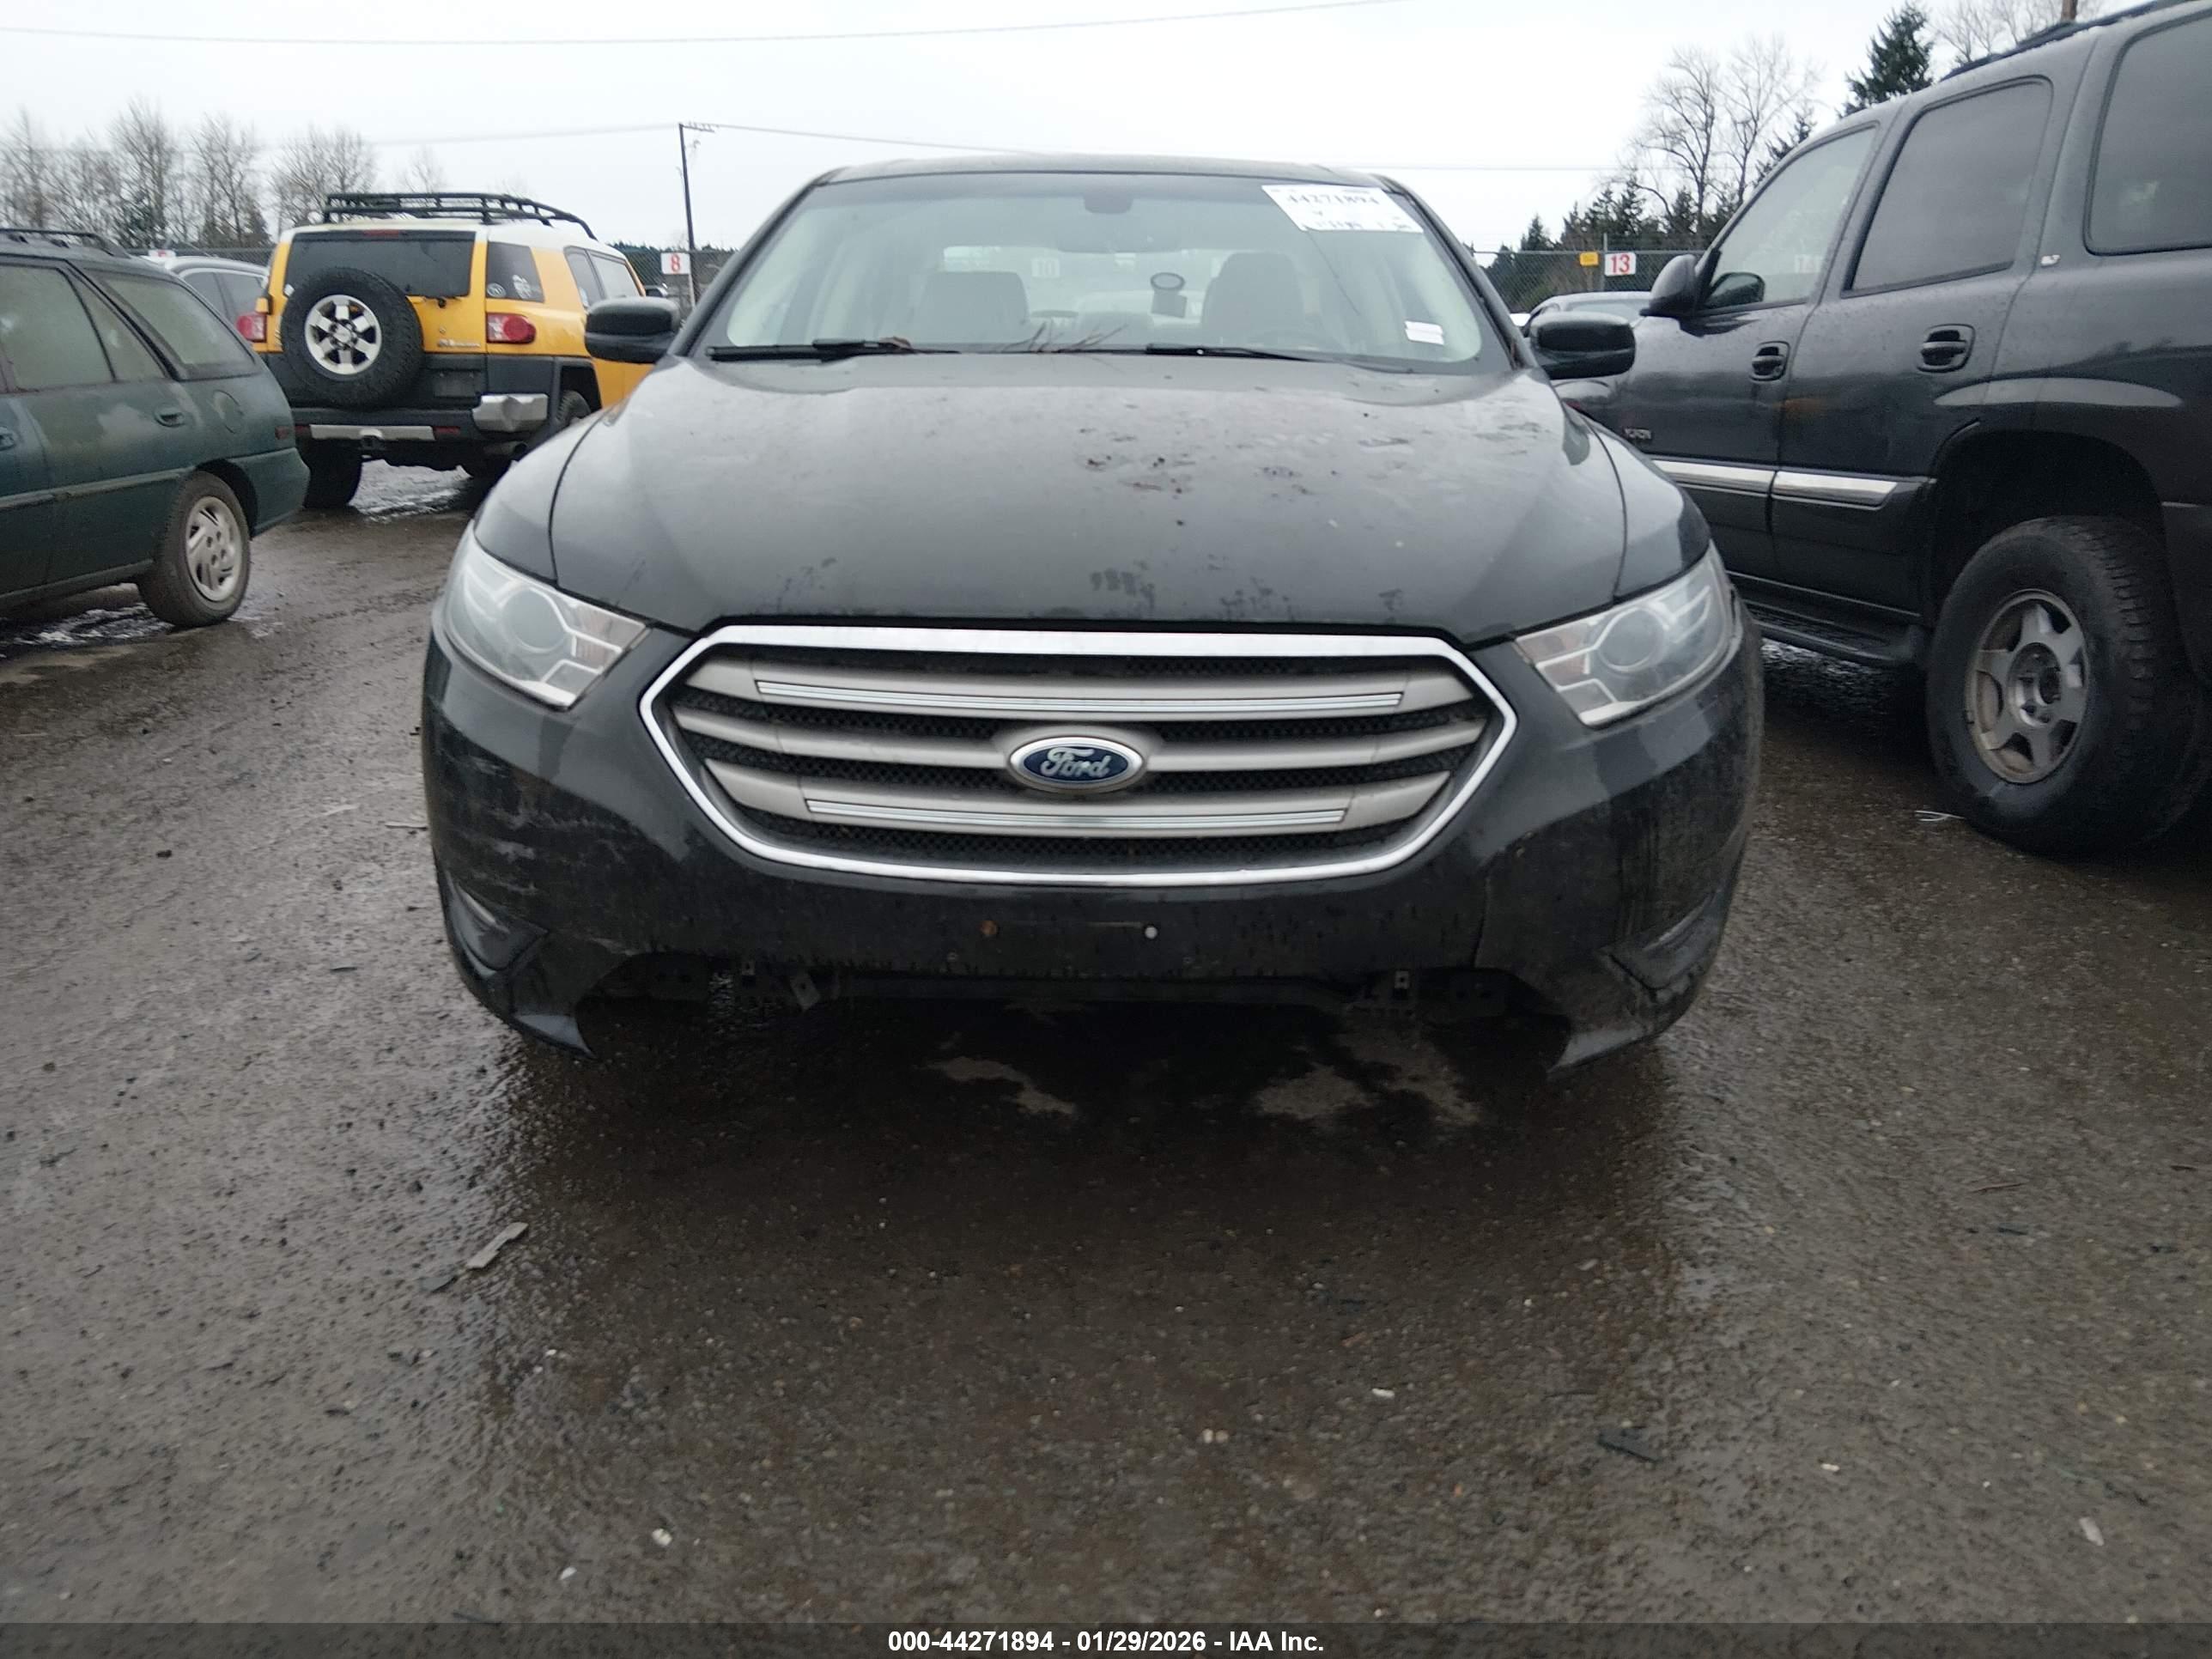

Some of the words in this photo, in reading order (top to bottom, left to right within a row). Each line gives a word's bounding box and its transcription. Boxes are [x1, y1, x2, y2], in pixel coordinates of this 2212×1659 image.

[670, 253, 681, 273] 8
[1610, 253, 1631, 274] 13
[1041, 746, 1112, 778] Ford
